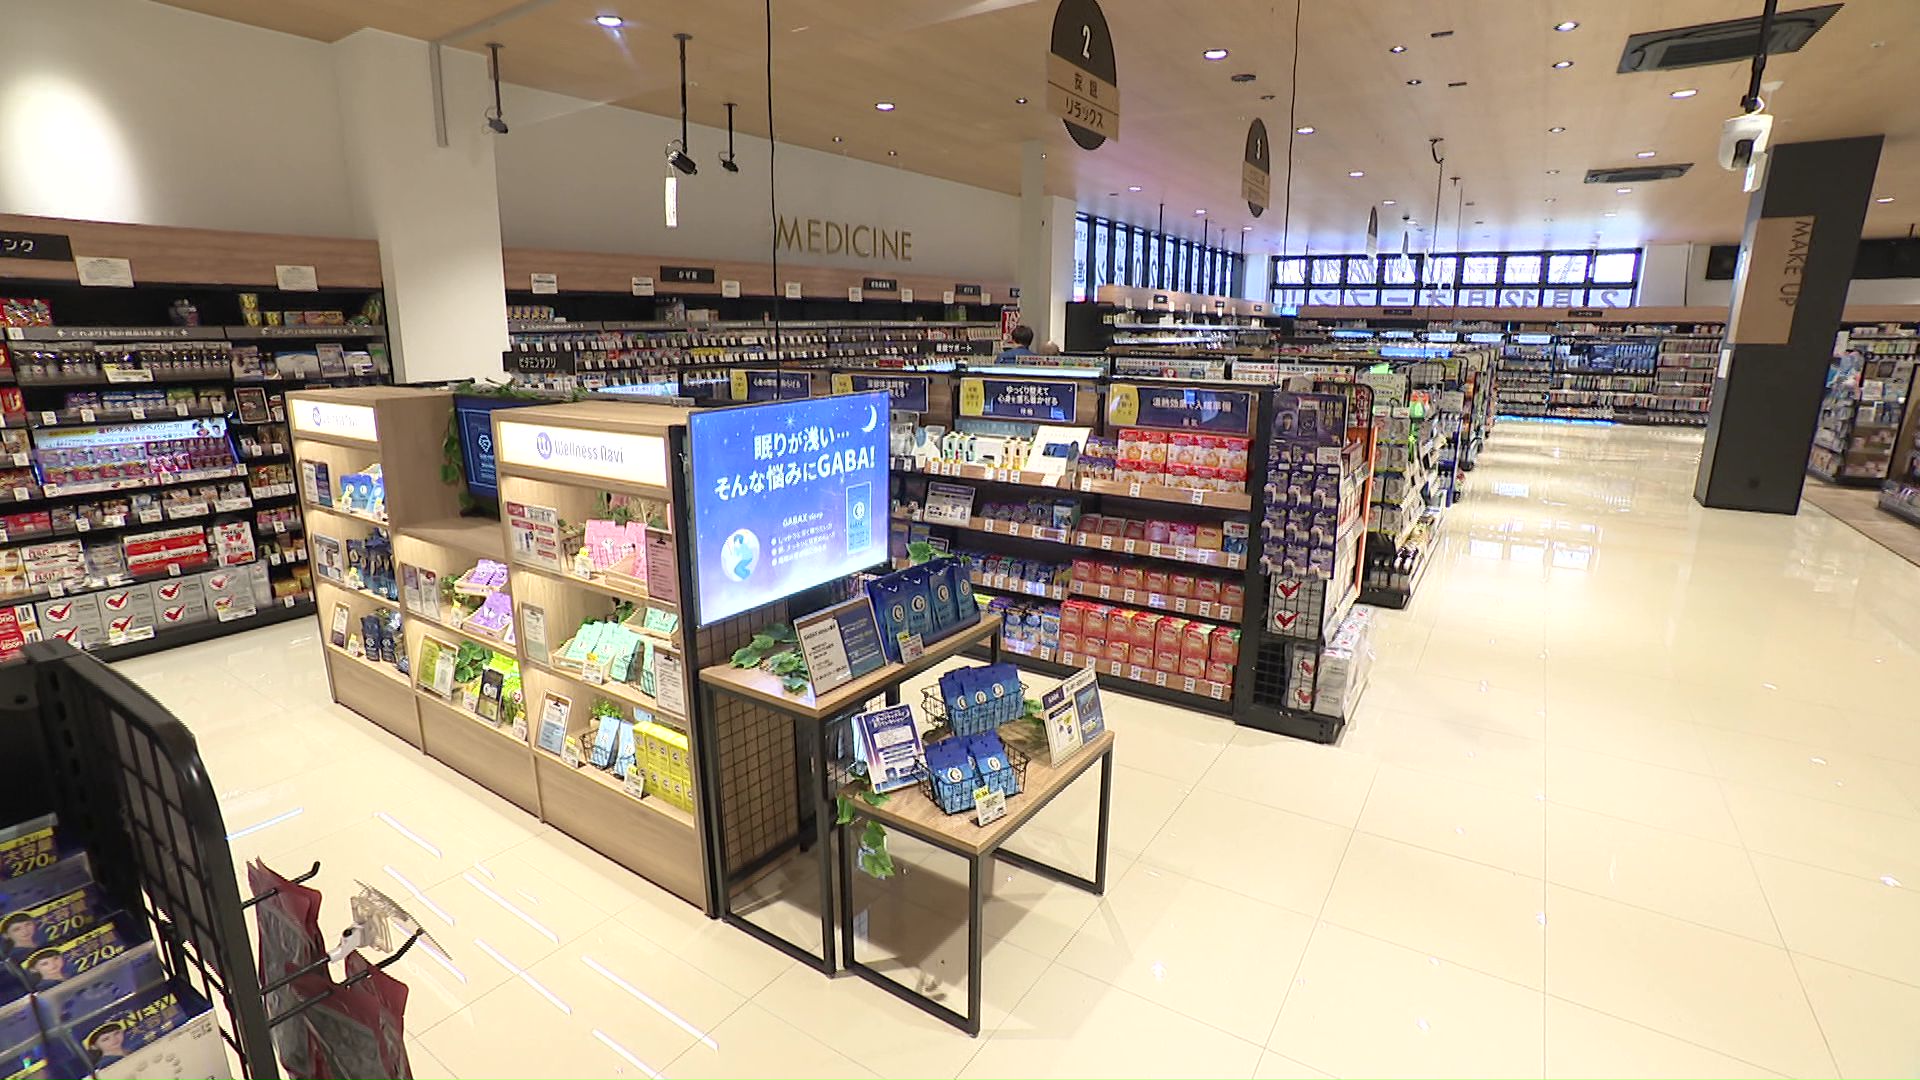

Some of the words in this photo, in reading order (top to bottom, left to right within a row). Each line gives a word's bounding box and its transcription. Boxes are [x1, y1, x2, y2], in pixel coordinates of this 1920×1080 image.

[1082, 25, 1091, 59] 2
[1065, 97, 1104, 128] リラックス
[0, 239, 34, 252] ンク
[775, 216, 912, 261] MEDICINE
[1784, 221, 1811, 275] MAKE
[1779, 284, 1801, 306] UP
[554, 440, 598, 461] Wellness
[714, 446, 875, 500] そんな悩みにGABA!
[120, 994, 177, 1030] NEW
